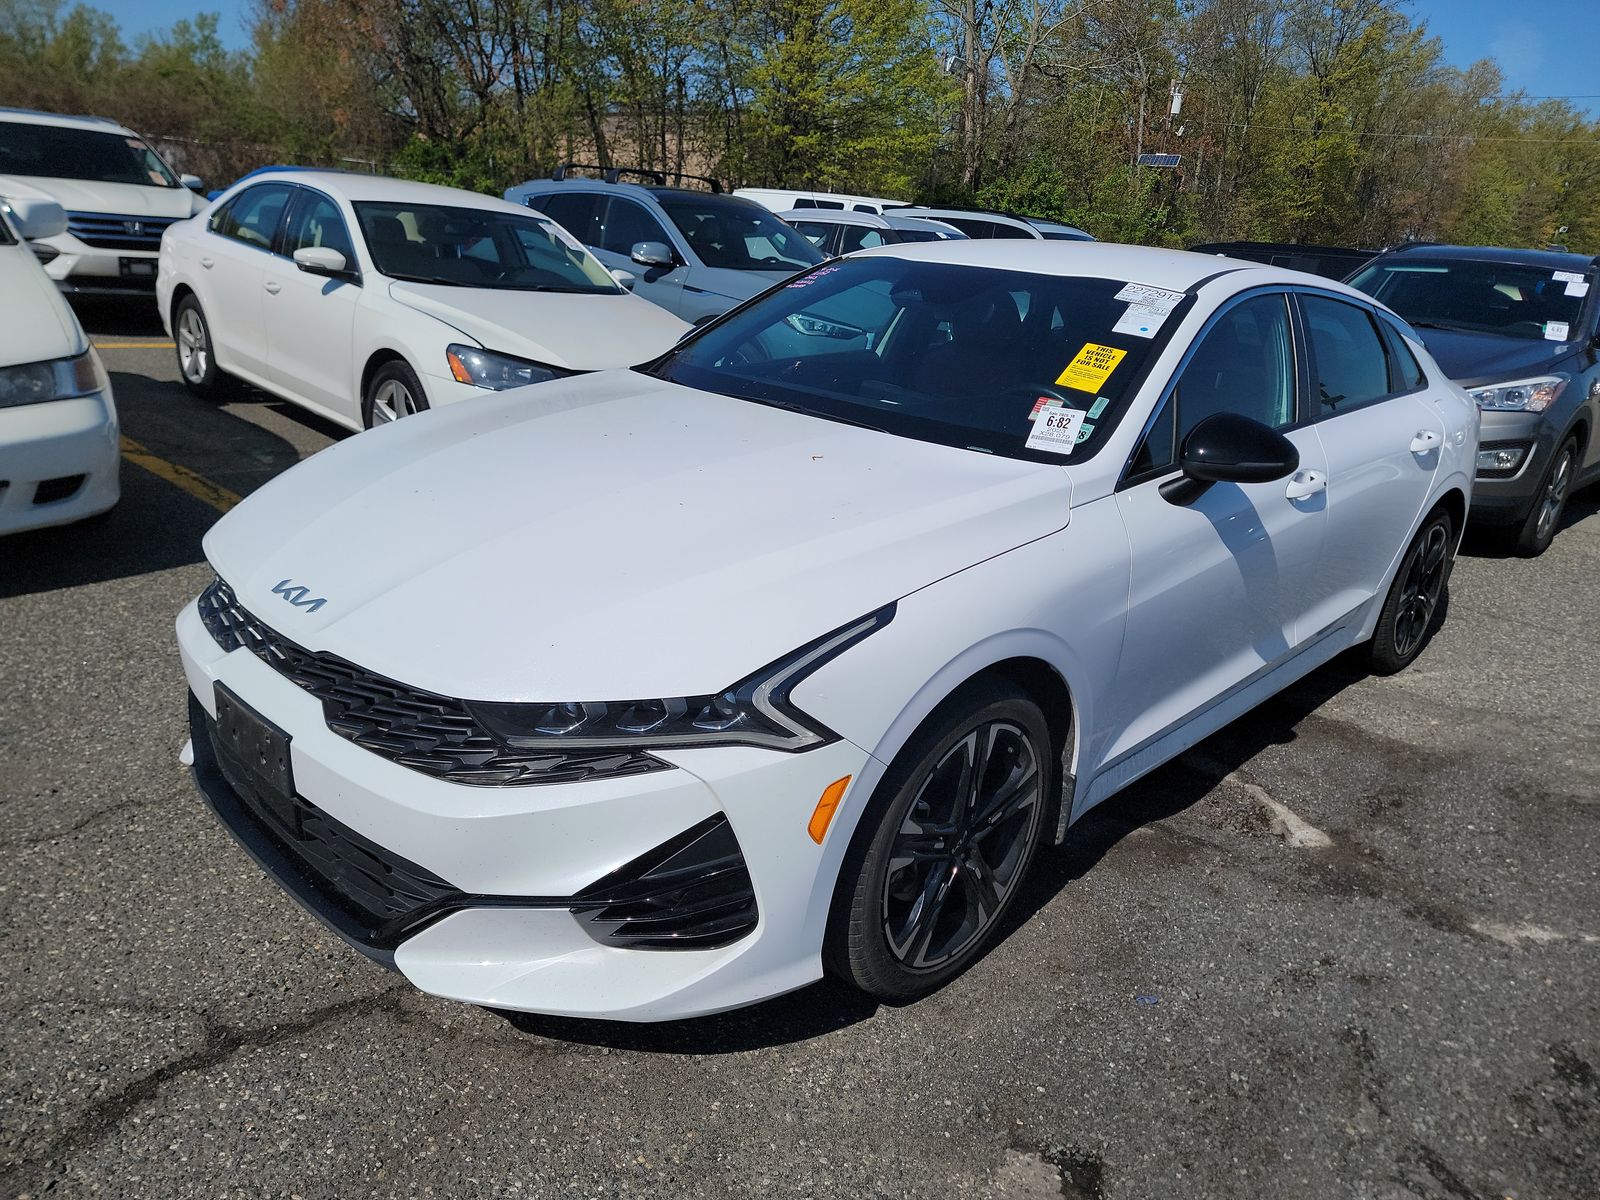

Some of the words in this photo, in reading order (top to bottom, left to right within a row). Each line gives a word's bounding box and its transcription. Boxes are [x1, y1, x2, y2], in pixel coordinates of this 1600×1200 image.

[1124, 285, 1183, 302] 2272912
[1085, 349, 1117, 360] VEHICLE
[1096, 346, 1113, 354] THIS
[1091, 362, 1111, 371] SALE
[1046, 415, 1071, 429] 6:82
